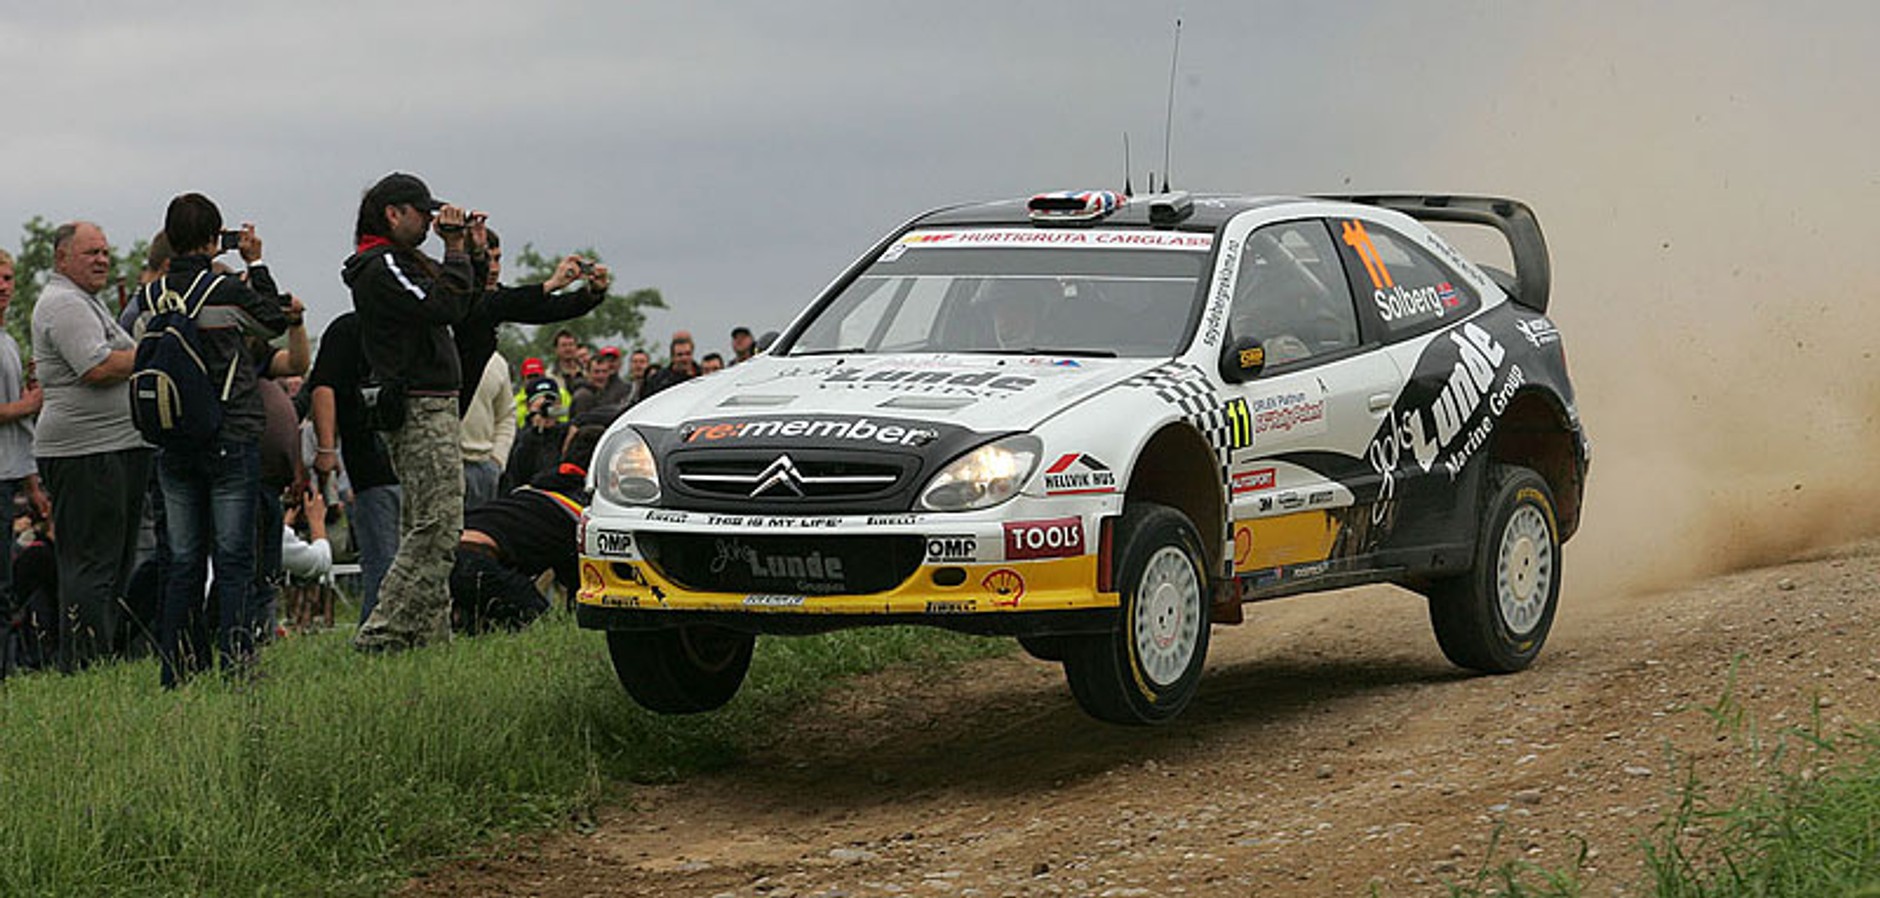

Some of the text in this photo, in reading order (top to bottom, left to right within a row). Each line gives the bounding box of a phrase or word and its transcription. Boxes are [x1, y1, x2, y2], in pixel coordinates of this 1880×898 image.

[959, 233, 1087, 242] HURTIGRUTA
[1096, 234, 1212, 246] CARGLASS
[1343, 219, 1393, 288] 11
[1374, 286, 1443, 321] Solberg
[824, 369, 1037, 391] Lunde
[1410, 322, 1505, 472] Lunde
[1228, 399, 1250, 448] 11
[1445, 364, 1526, 480] Marine Group
[1093, 472, 1116, 485] HUS
[768, 518, 795, 528] MY
[597, 532, 632, 553] OMP
[927, 538, 977, 557] OMP
[1012, 525, 1080, 549] TOOLS
[751, 551, 844, 579] Lunde
